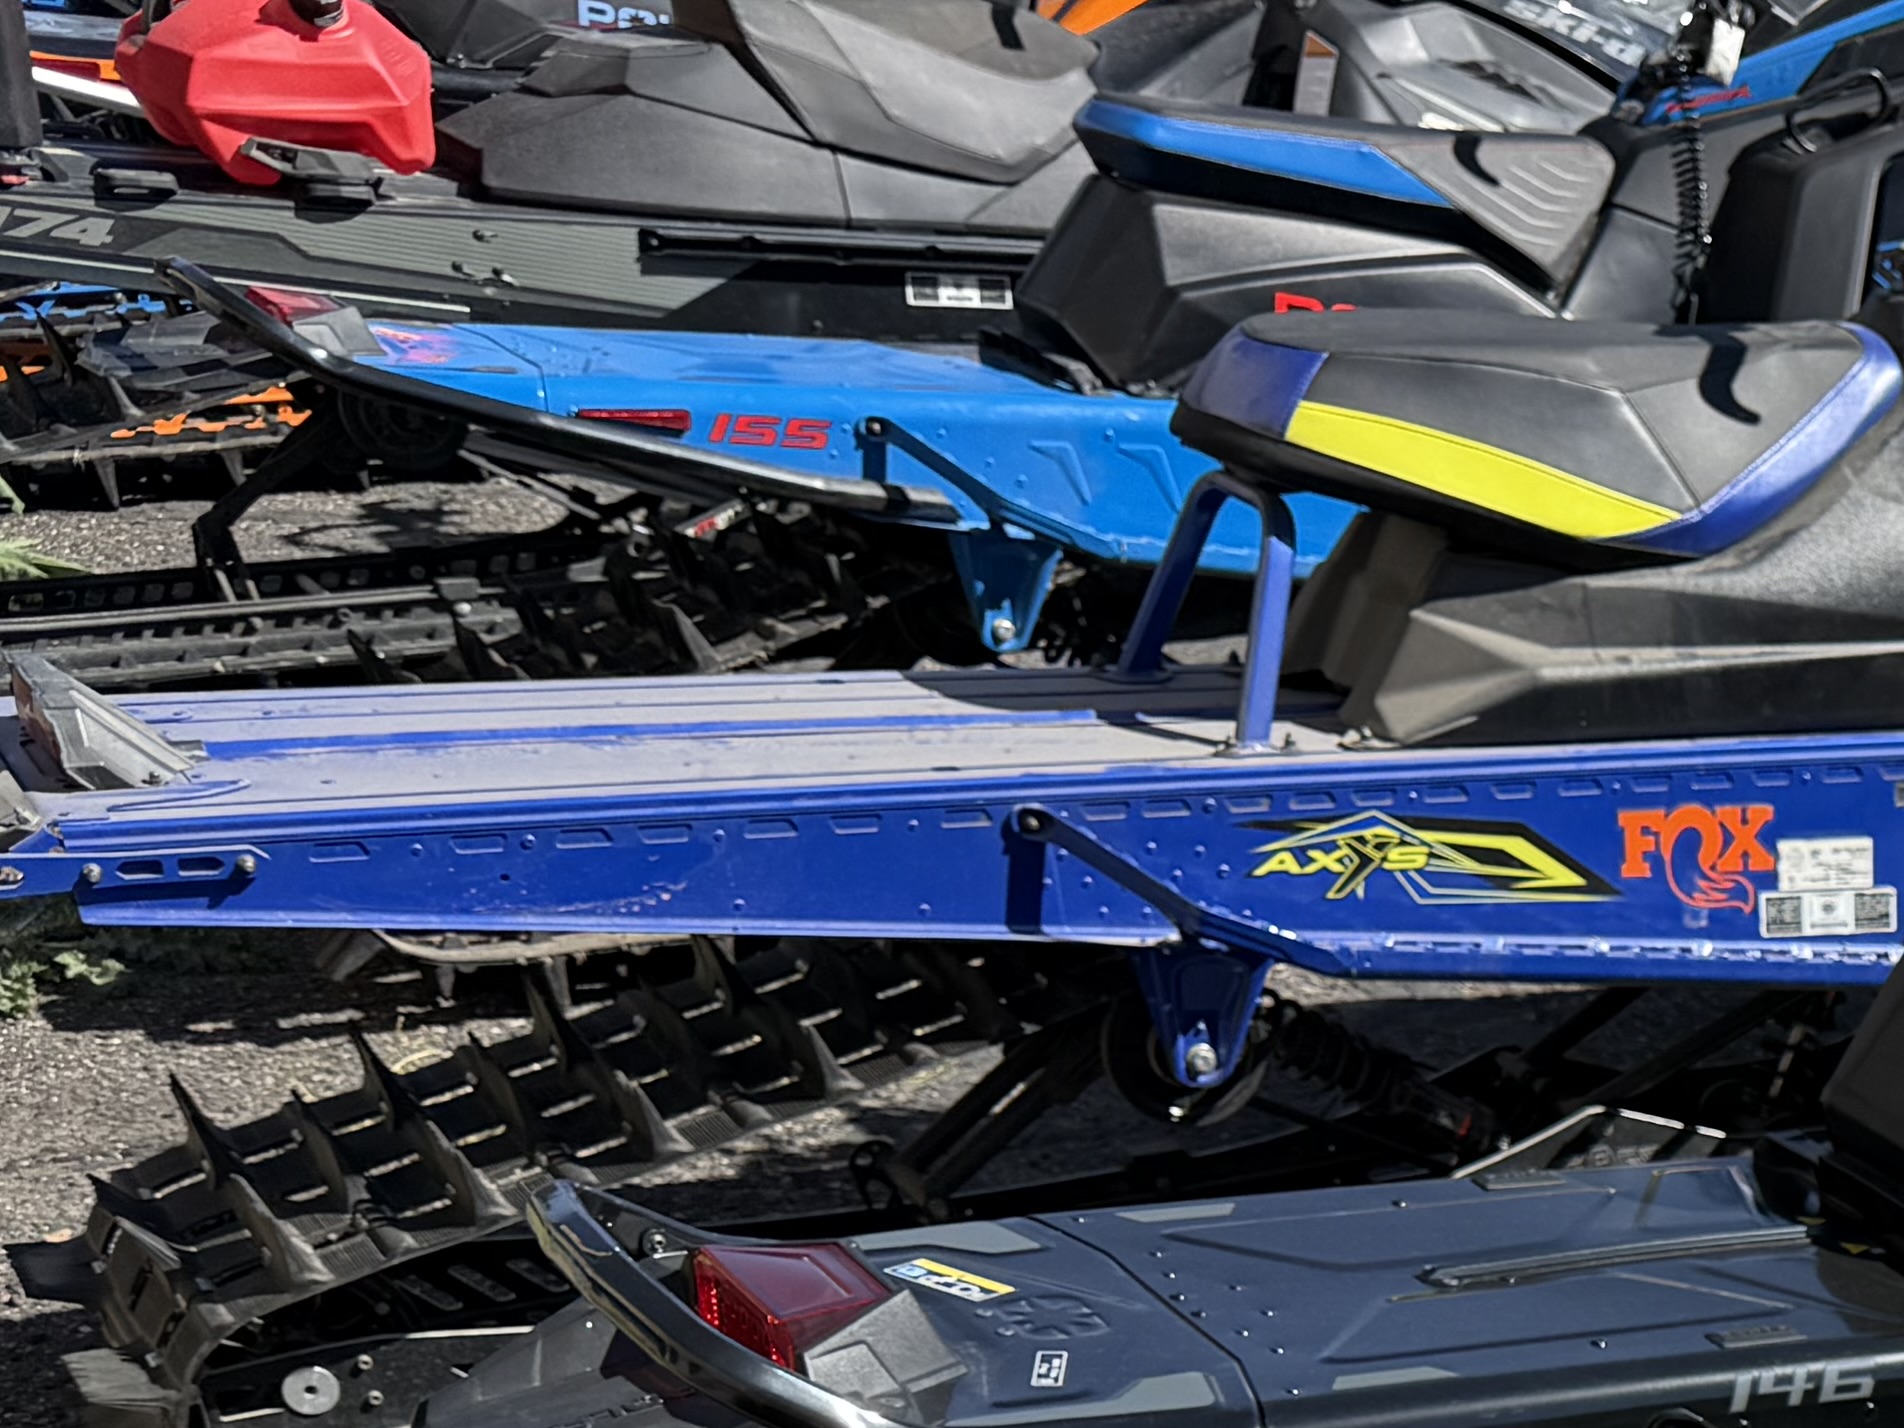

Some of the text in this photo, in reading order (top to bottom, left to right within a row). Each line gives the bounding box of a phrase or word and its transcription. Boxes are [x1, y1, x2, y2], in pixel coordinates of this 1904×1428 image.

[708, 412, 834, 450] 155
[1252, 831, 1430, 900] AXYS
[1617, 803, 1776, 880] FOX
[1728, 1363, 1878, 1413] 146
